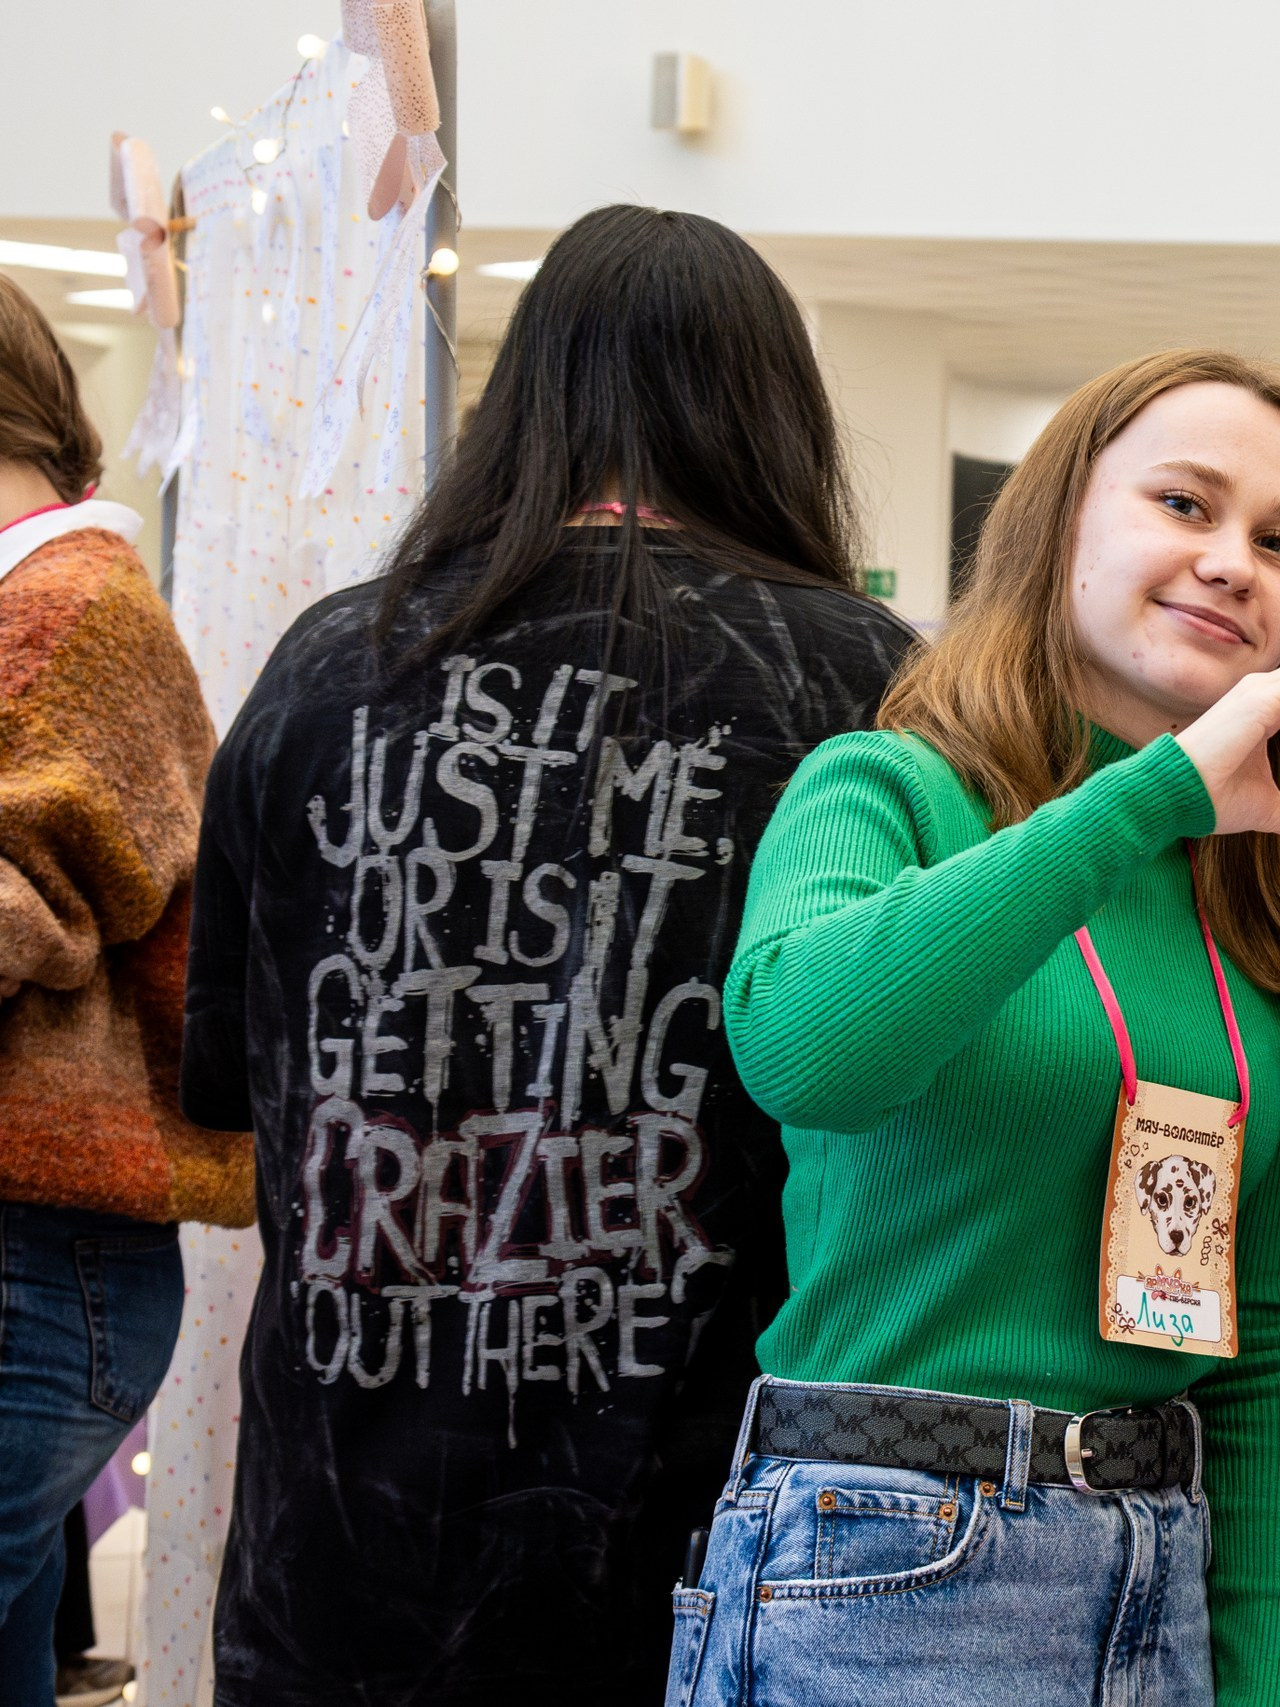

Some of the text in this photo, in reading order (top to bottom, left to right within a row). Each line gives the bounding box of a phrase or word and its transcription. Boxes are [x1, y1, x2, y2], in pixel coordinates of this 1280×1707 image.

[429, 654, 639, 752] IS IT
[305, 705, 736, 868] JUST ME,
[348, 848, 706, 974] OR IS IT
[308, 954, 722, 1128] GETTING
[1135, 1117, 1225, 1149] МЯУ-ВОЛОНТЁР
[303, 1100, 708, 1286] CRAZIER
[306, 1281, 461, 1389] OUT
[1136, 1291, 1194, 1347] Лиза
[904, 1421, 939, 1442] MK
[938, 1444, 970, 1466] MK
[942, 1406, 974, 1427] MK
